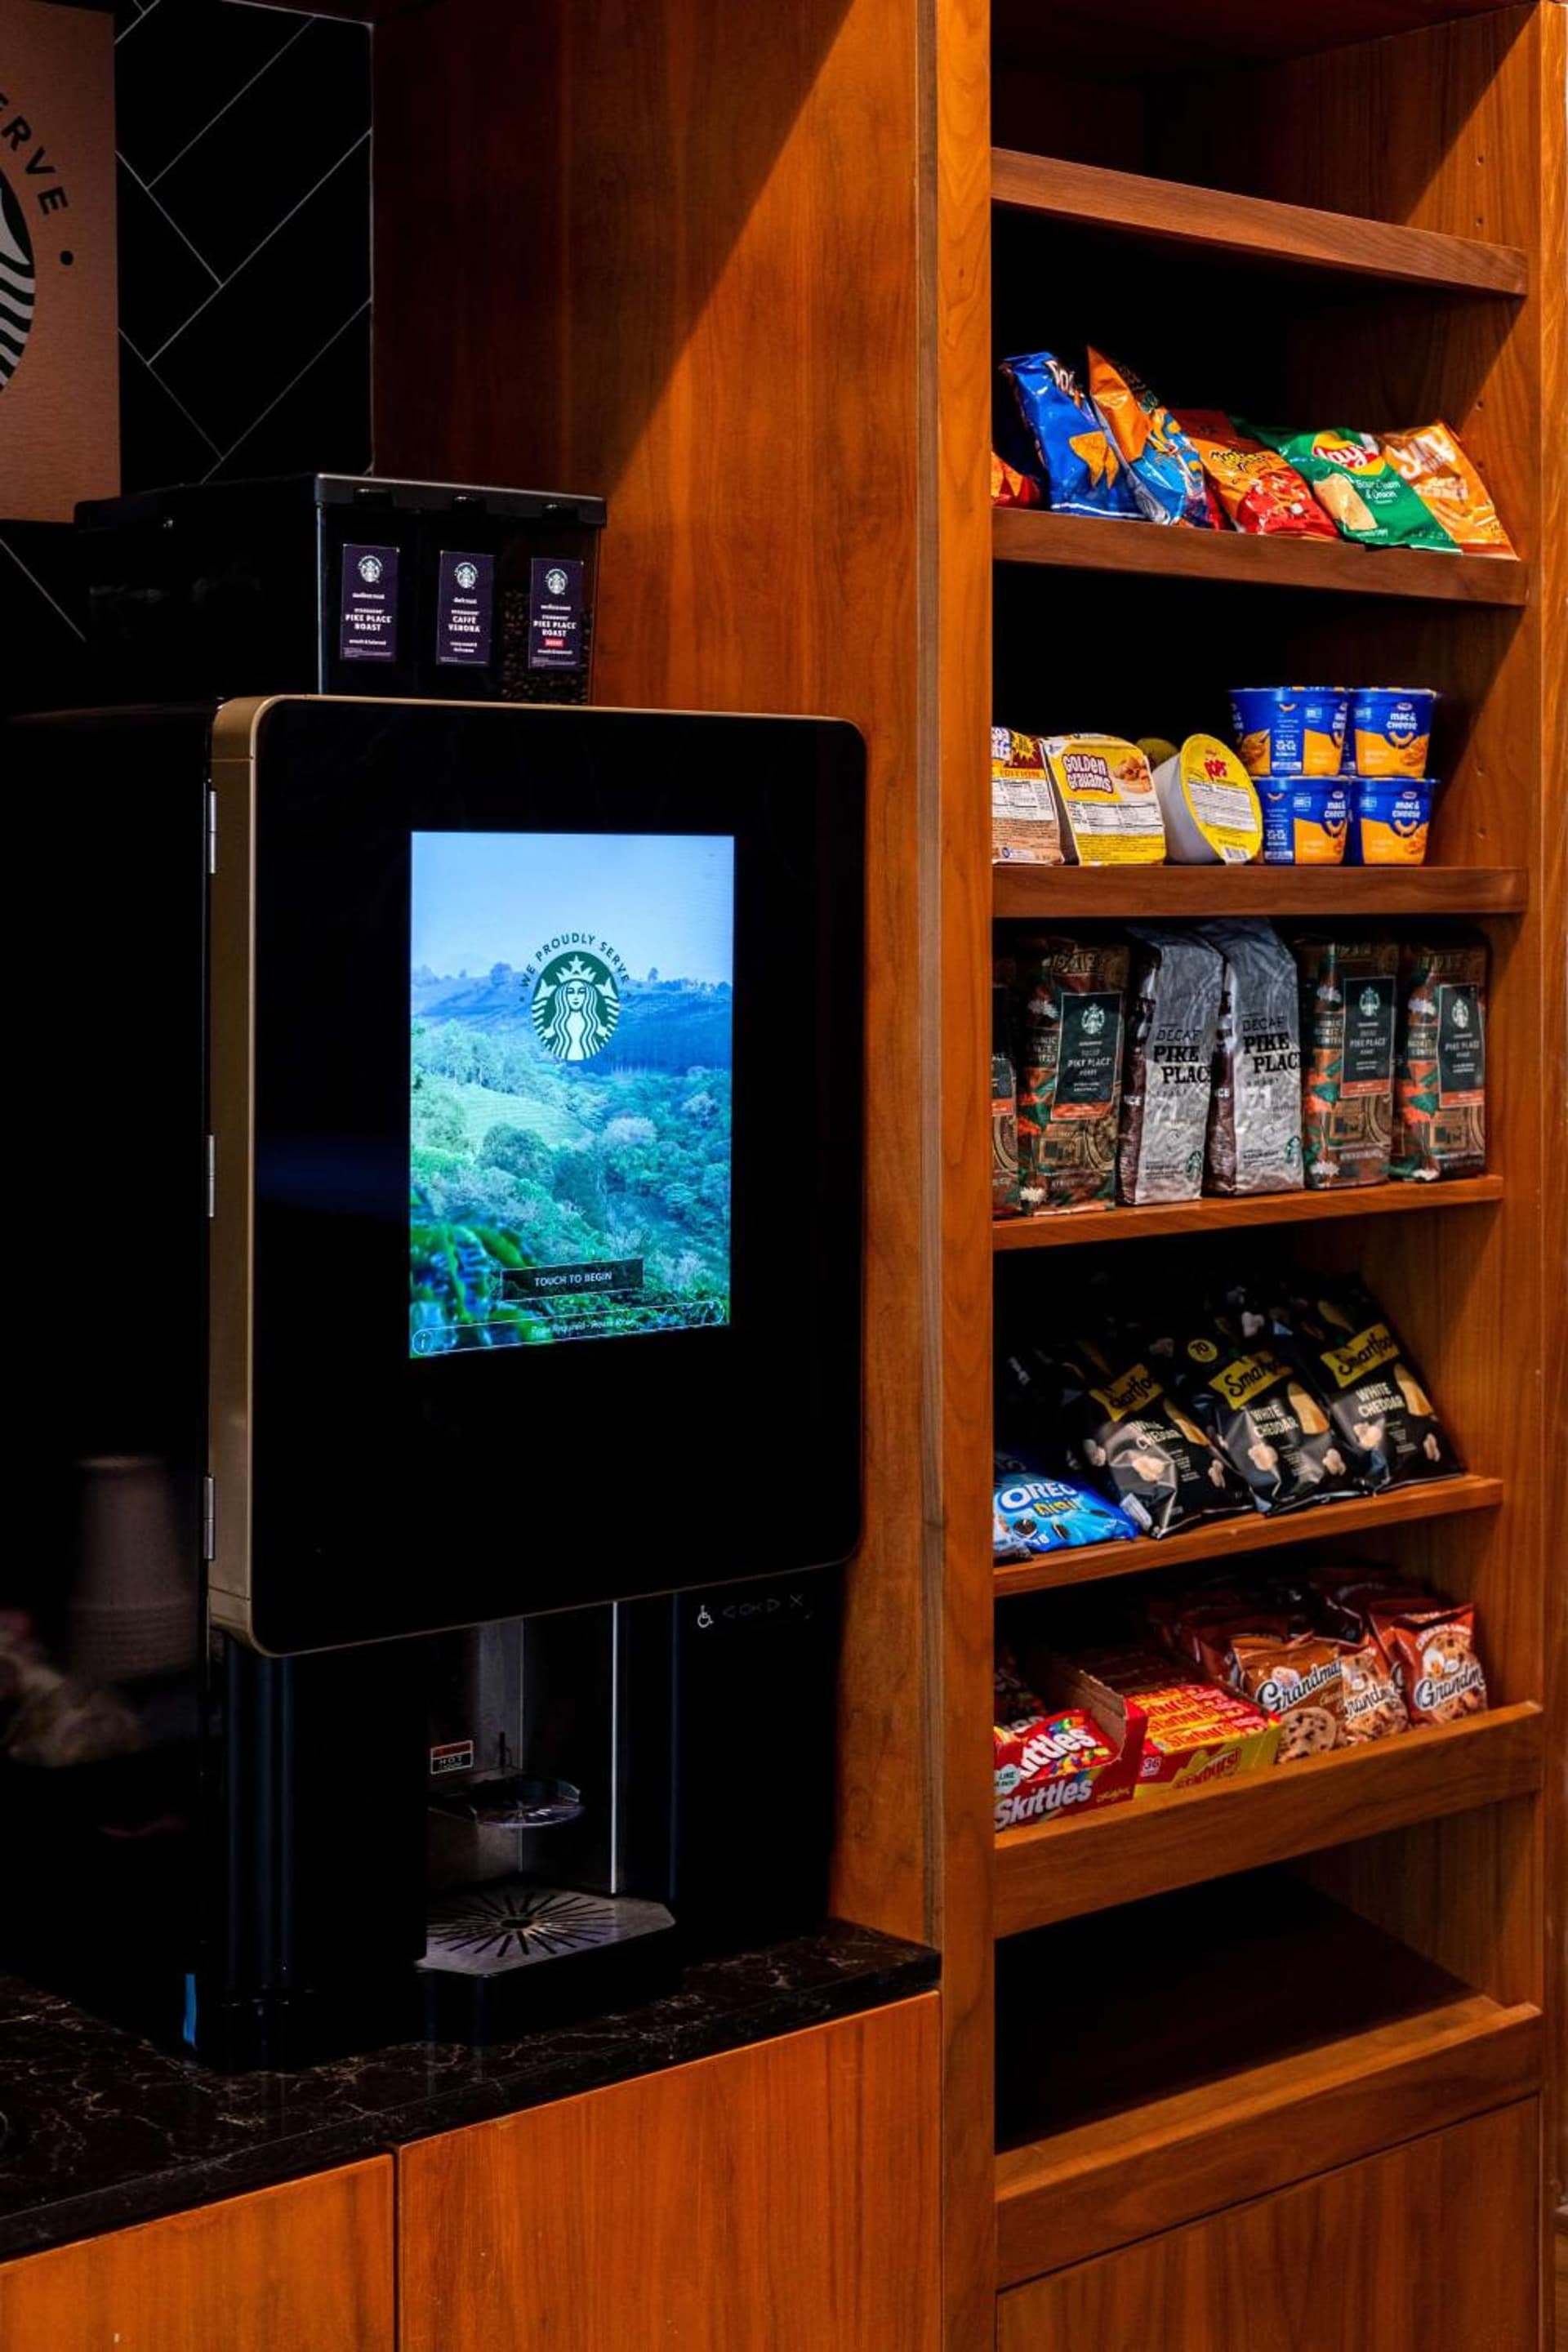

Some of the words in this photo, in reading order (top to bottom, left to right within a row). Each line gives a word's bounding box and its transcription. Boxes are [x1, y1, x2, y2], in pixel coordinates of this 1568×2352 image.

[0, 92, 68, 214] RVE
[519, 964, 537, 987] WE
[535, 933, 595, 962] PROUDLY
[599, 942, 630, 984] SERVE
[1154, 1046, 1199, 1062] PIKE
[1243, 1032, 1289, 1054] PIKE
[534, 1276, 567, 1287] TOUCH
[569, 1274, 582, 1285] TO
[585, 1272, 612, 1282] BEGIN
[1356, 1382, 1392, 1402] WHITE
[994, 1779, 1094, 1832] Skittles
